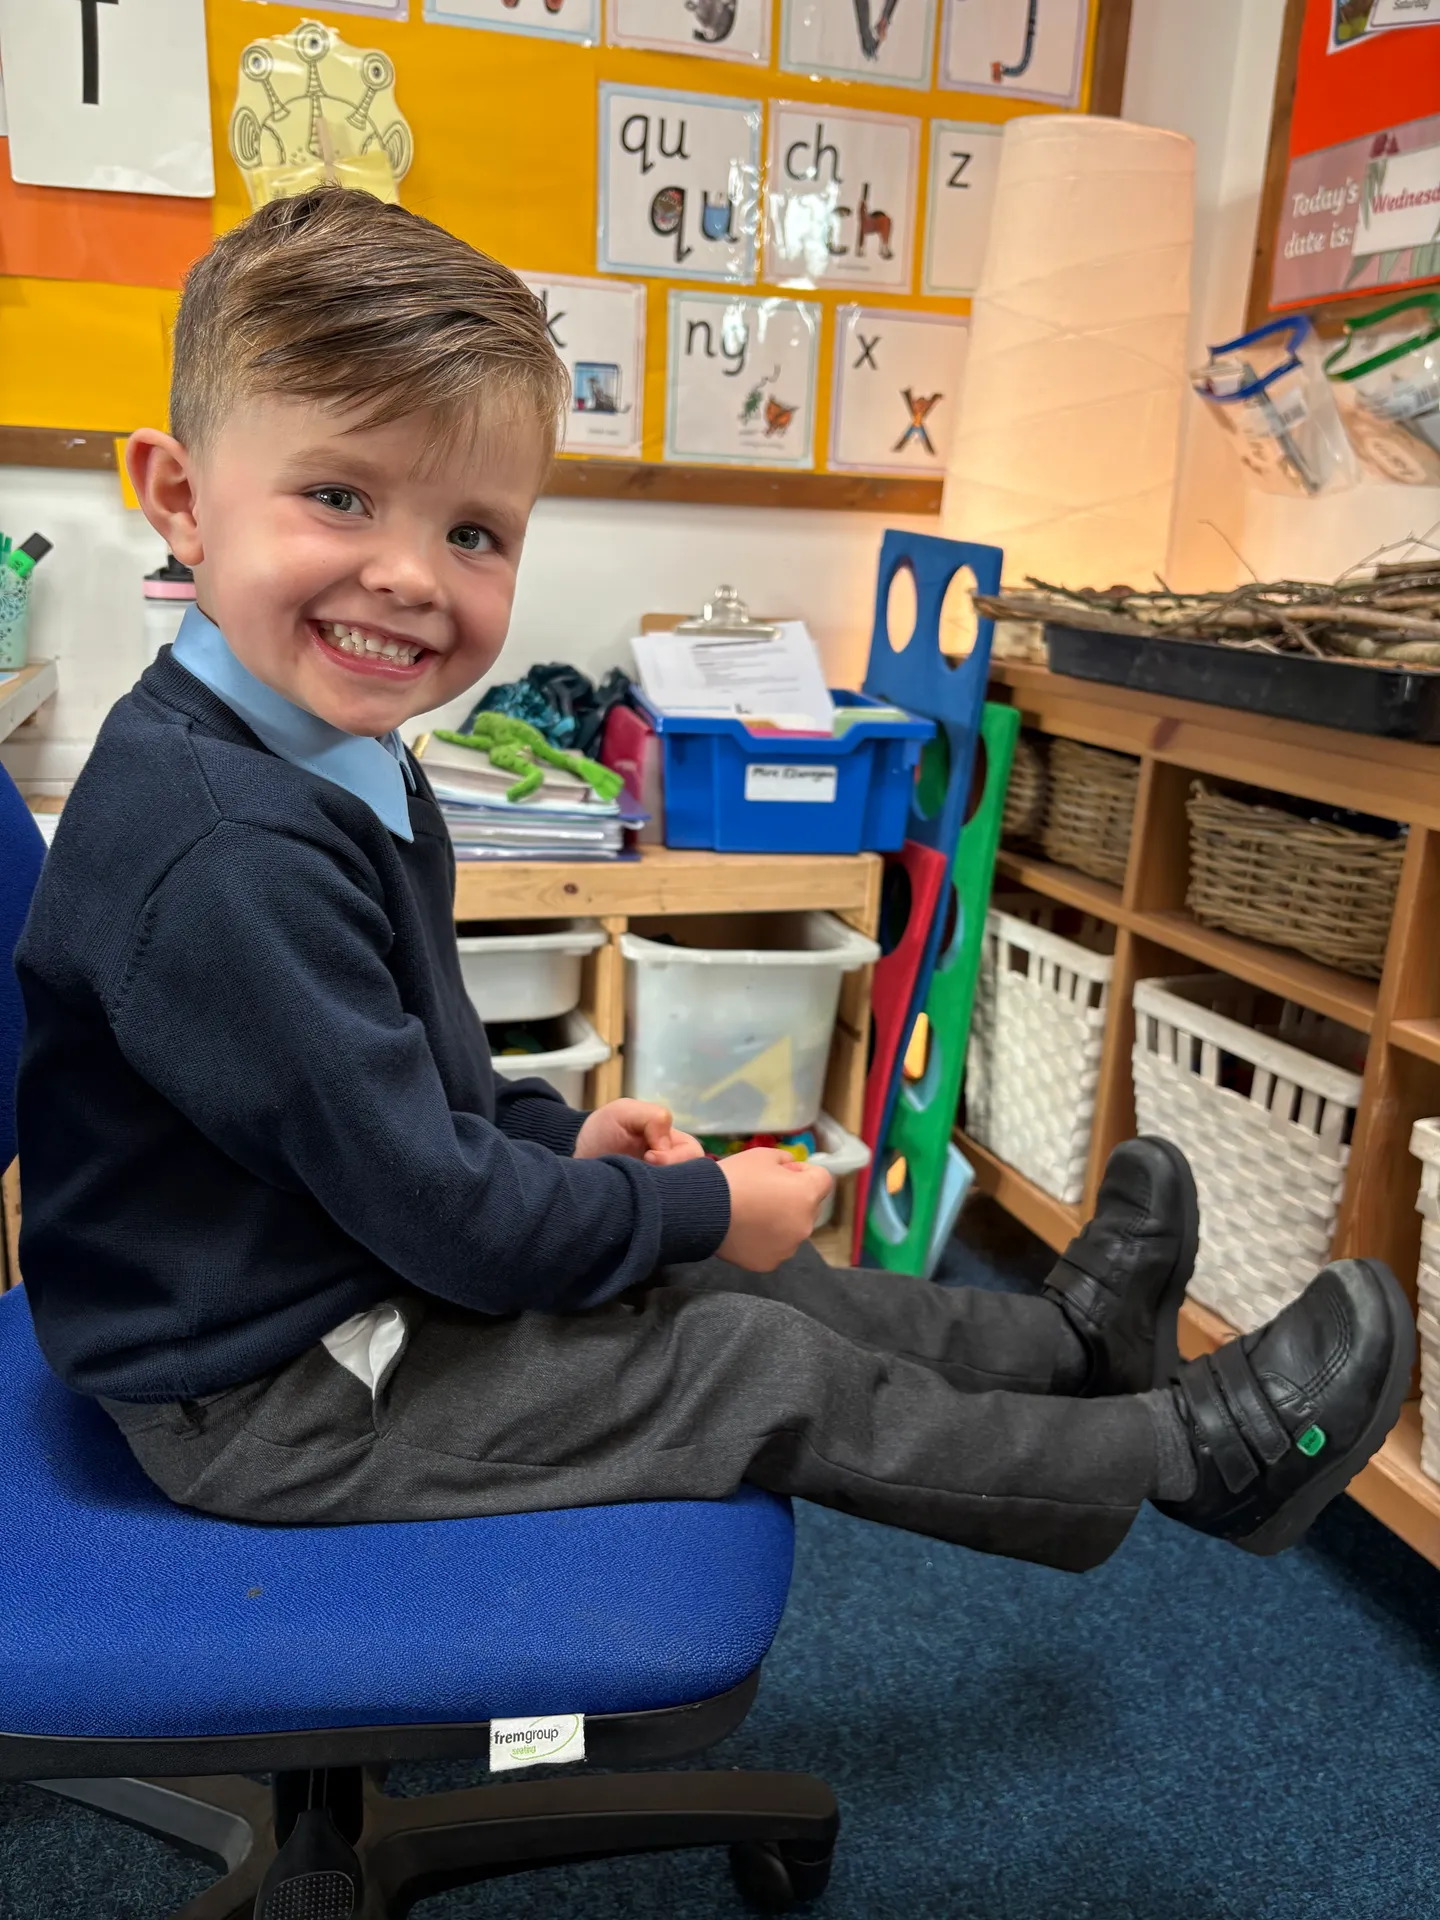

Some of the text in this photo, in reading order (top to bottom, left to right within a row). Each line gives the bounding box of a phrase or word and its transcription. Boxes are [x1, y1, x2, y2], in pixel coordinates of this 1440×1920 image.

[620, 113, 692, 176] qu
[786, 123, 843, 184] ch
[946, 151, 972, 189] z
[1292, 176, 1359, 218] Today's
[1284, 222, 1353, 260] date is:
[853, 334, 881, 370] x
[494, 1728, 559, 1744] fremgroup
